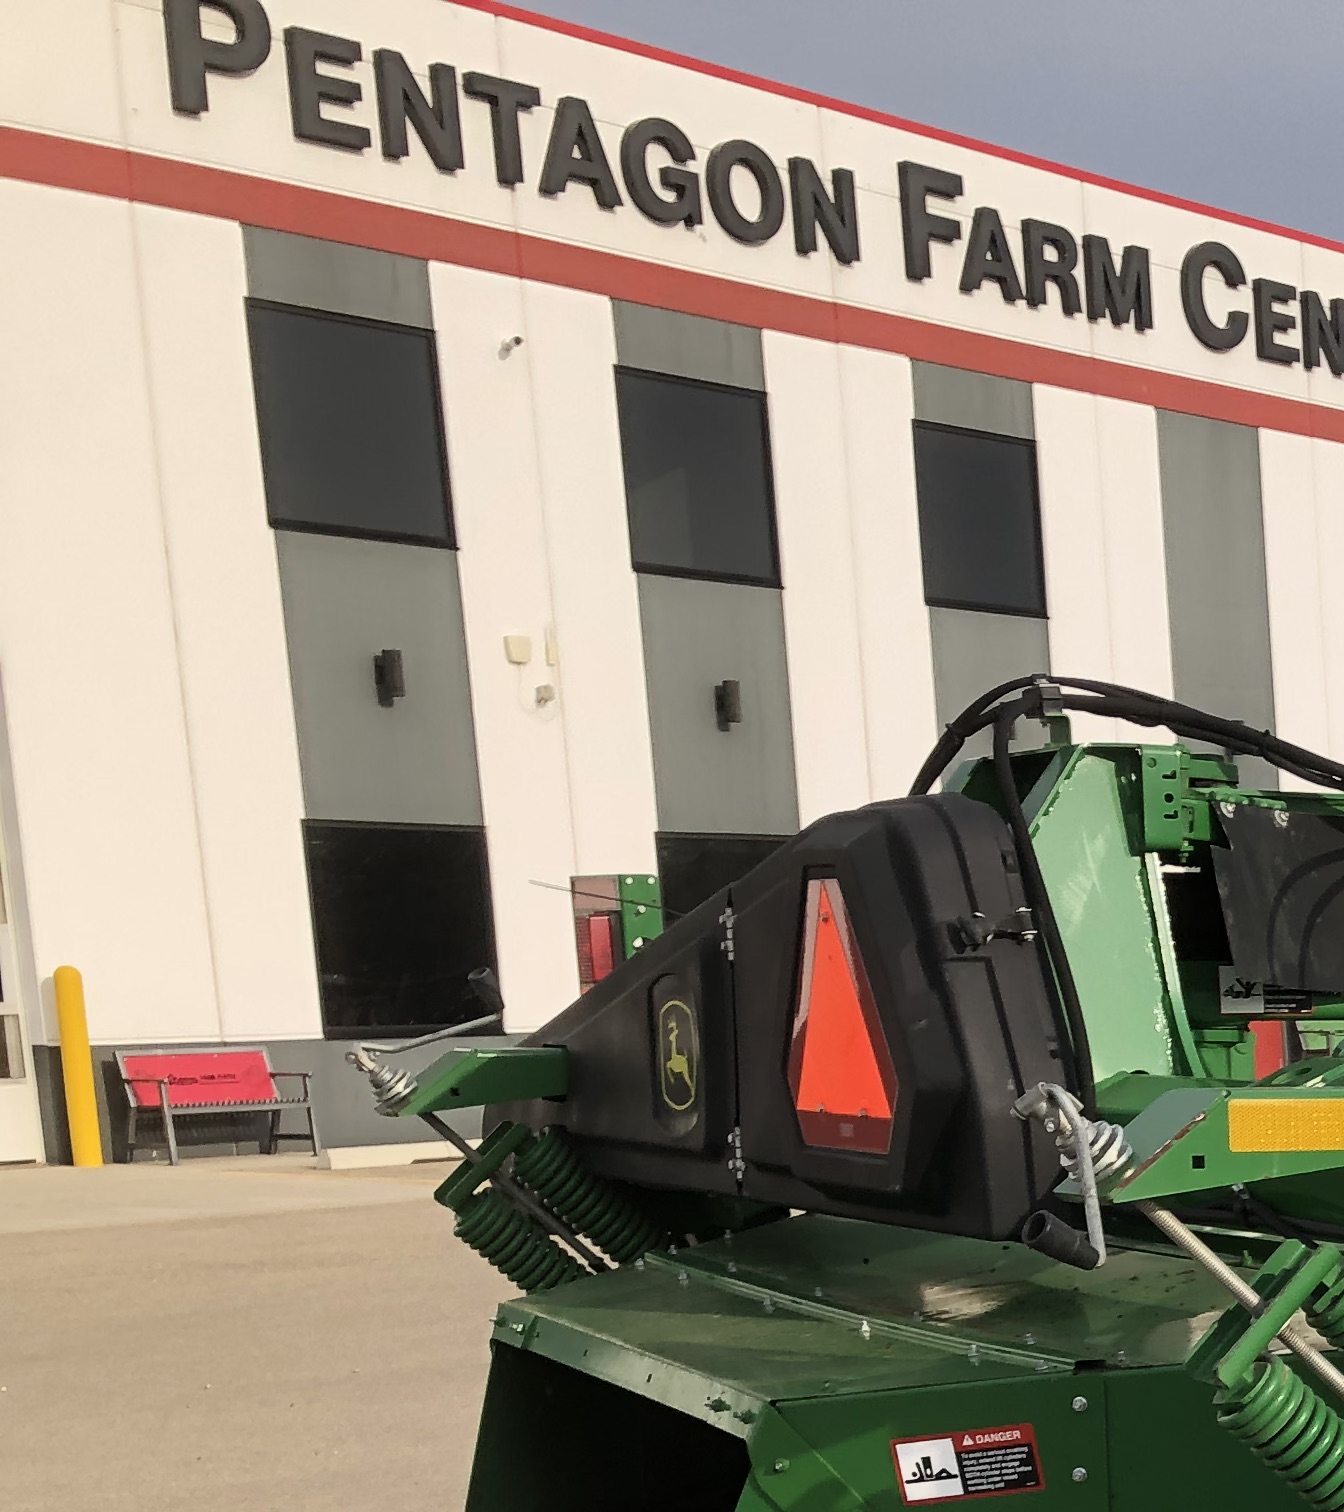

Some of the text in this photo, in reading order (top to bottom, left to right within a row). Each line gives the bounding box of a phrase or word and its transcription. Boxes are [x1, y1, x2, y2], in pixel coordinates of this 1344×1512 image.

[163, 0, 861, 265] PENTAGON
[897, 160, 1154, 332] FARM
[975, 1430, 1021, 1443] DANGER
